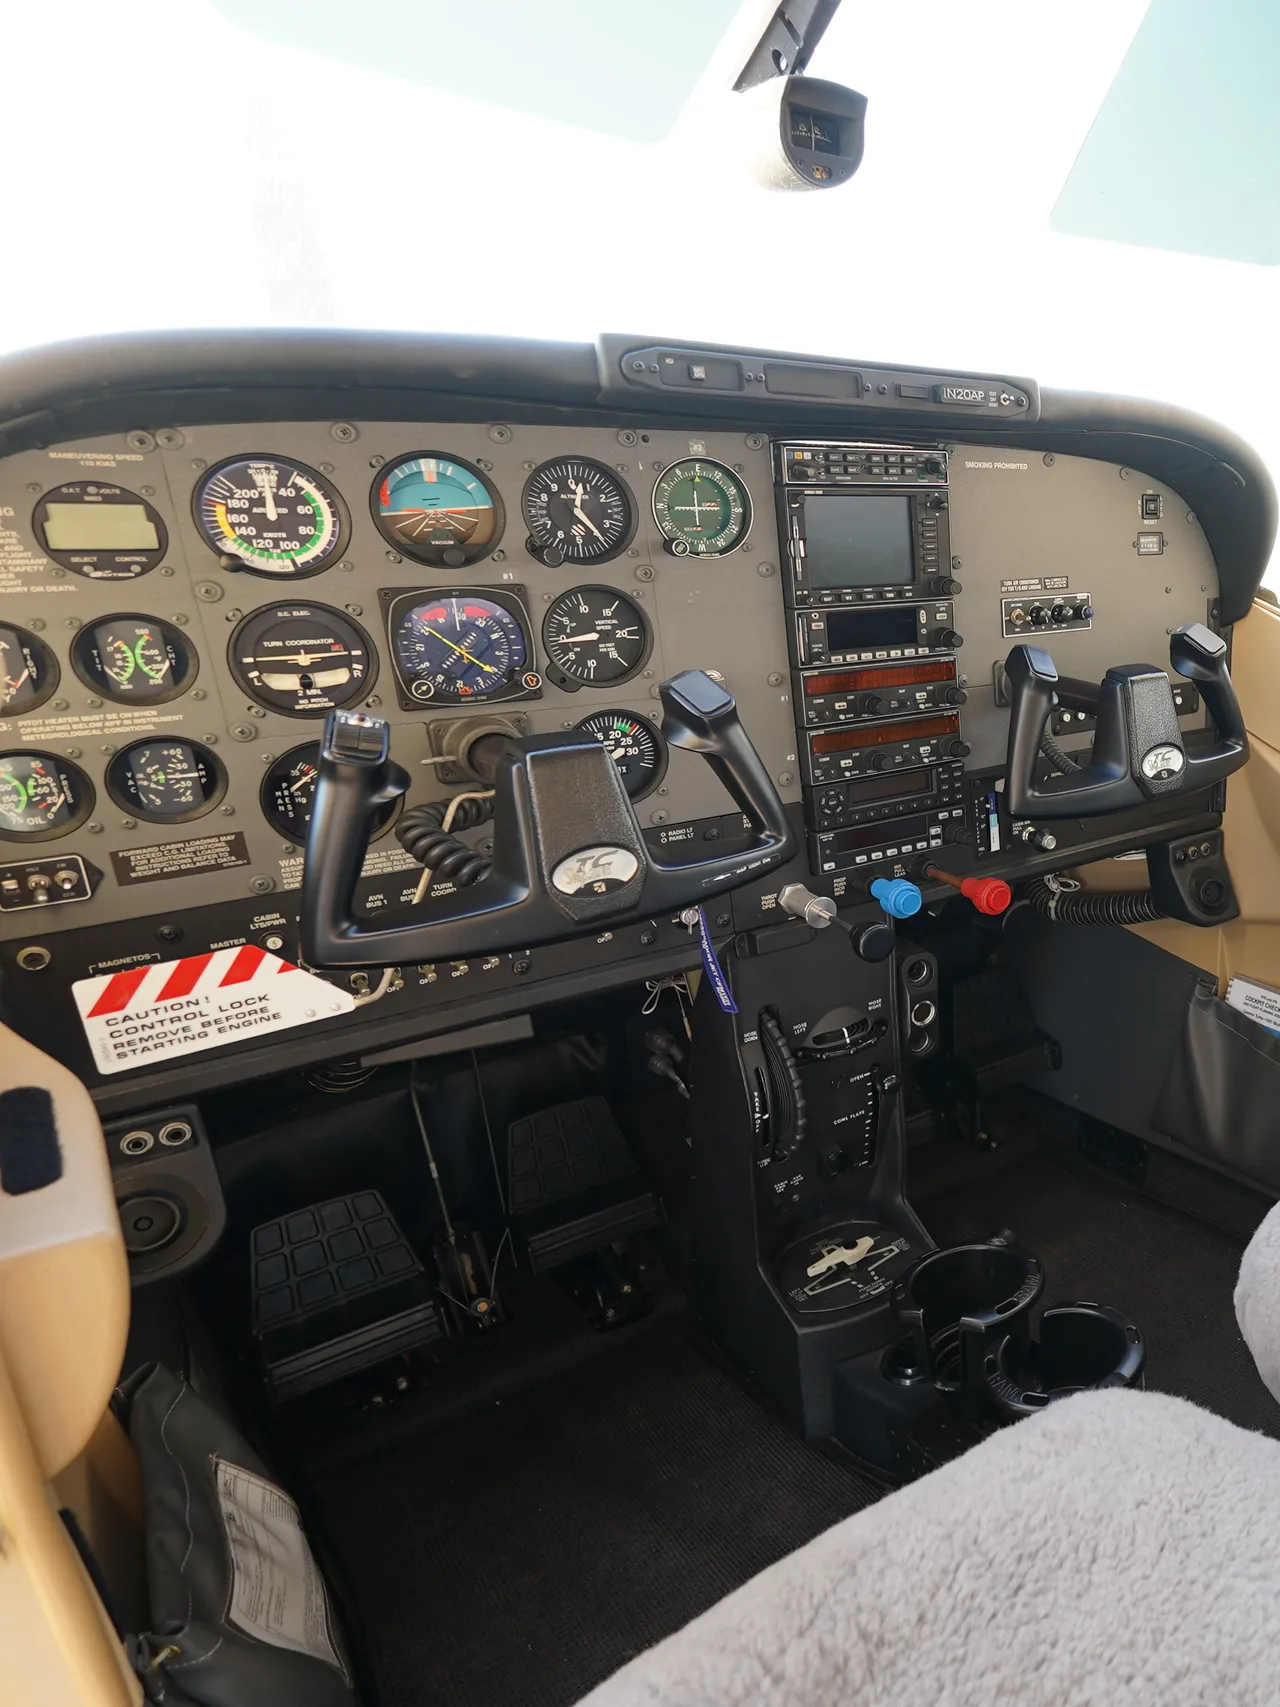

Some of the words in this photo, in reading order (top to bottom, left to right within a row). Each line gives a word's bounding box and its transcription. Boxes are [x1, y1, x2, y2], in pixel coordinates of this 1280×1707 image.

[279, 488, 295, 497] 40
[551, 484, 558, 492] 9
[234, 490, 258, 498] 200
[228, 499, 249, 508] 180
[297, 506, 313, 514] 60
[228, 514, 248, 523] 160
[235, 527, 256, 535] 140
[299, 527, 314, 535] 80
[252, 539, 273, 548] 120
[280, 541, 300, 550] 100
[20, 724, 70, 734] OPERATING
[134, 714, 183, 724] INSTRUMENT
[22, 730, 102, 741] METEOROLOGICAL
[126, 772, 137, 793] VAC
[275, 792, 285, 811] MAN
[282, 782, 294, 817] PRESS
[119, 847, 158, 857] FORWARD
[186, 838, 218, 847] LOADING
[130, 852, 162, 860] EXCEED
[150, 853, 195, 863] ADDITIONAL
[197, 847, 230, 856] LOADING
[130, 869, 160, 877] WEIGHT
[181, 860, 216, 869] BALANCE
[135, 858, 192, 871] INSTRUCTIONS
[254, 913, 280, 922] CABIN
[250, 918, 286, 930] LTS/PWR
[210, 938, 246, 949] MASTER
[98, 953, 151, 968] MAGNETOS
[1245, 995, 1264, 1006] COCKPIT
[106, 998, 200, 1027] CAUTION
[110, 1010, 209, 1039] CONTROL
[219, 994, 270, 1012] LOCK
[114, 1026, 192, 1050] REMOVE
[201, 1006, 269, 1028] BEFORE
[116, 1031, 209, 1059] STARTING
[218, 1012, 282, 1034] ENGINE
[850, 1074, 863, 1083] OPEN
[850, 1110, 865, 1119] FLAPS
